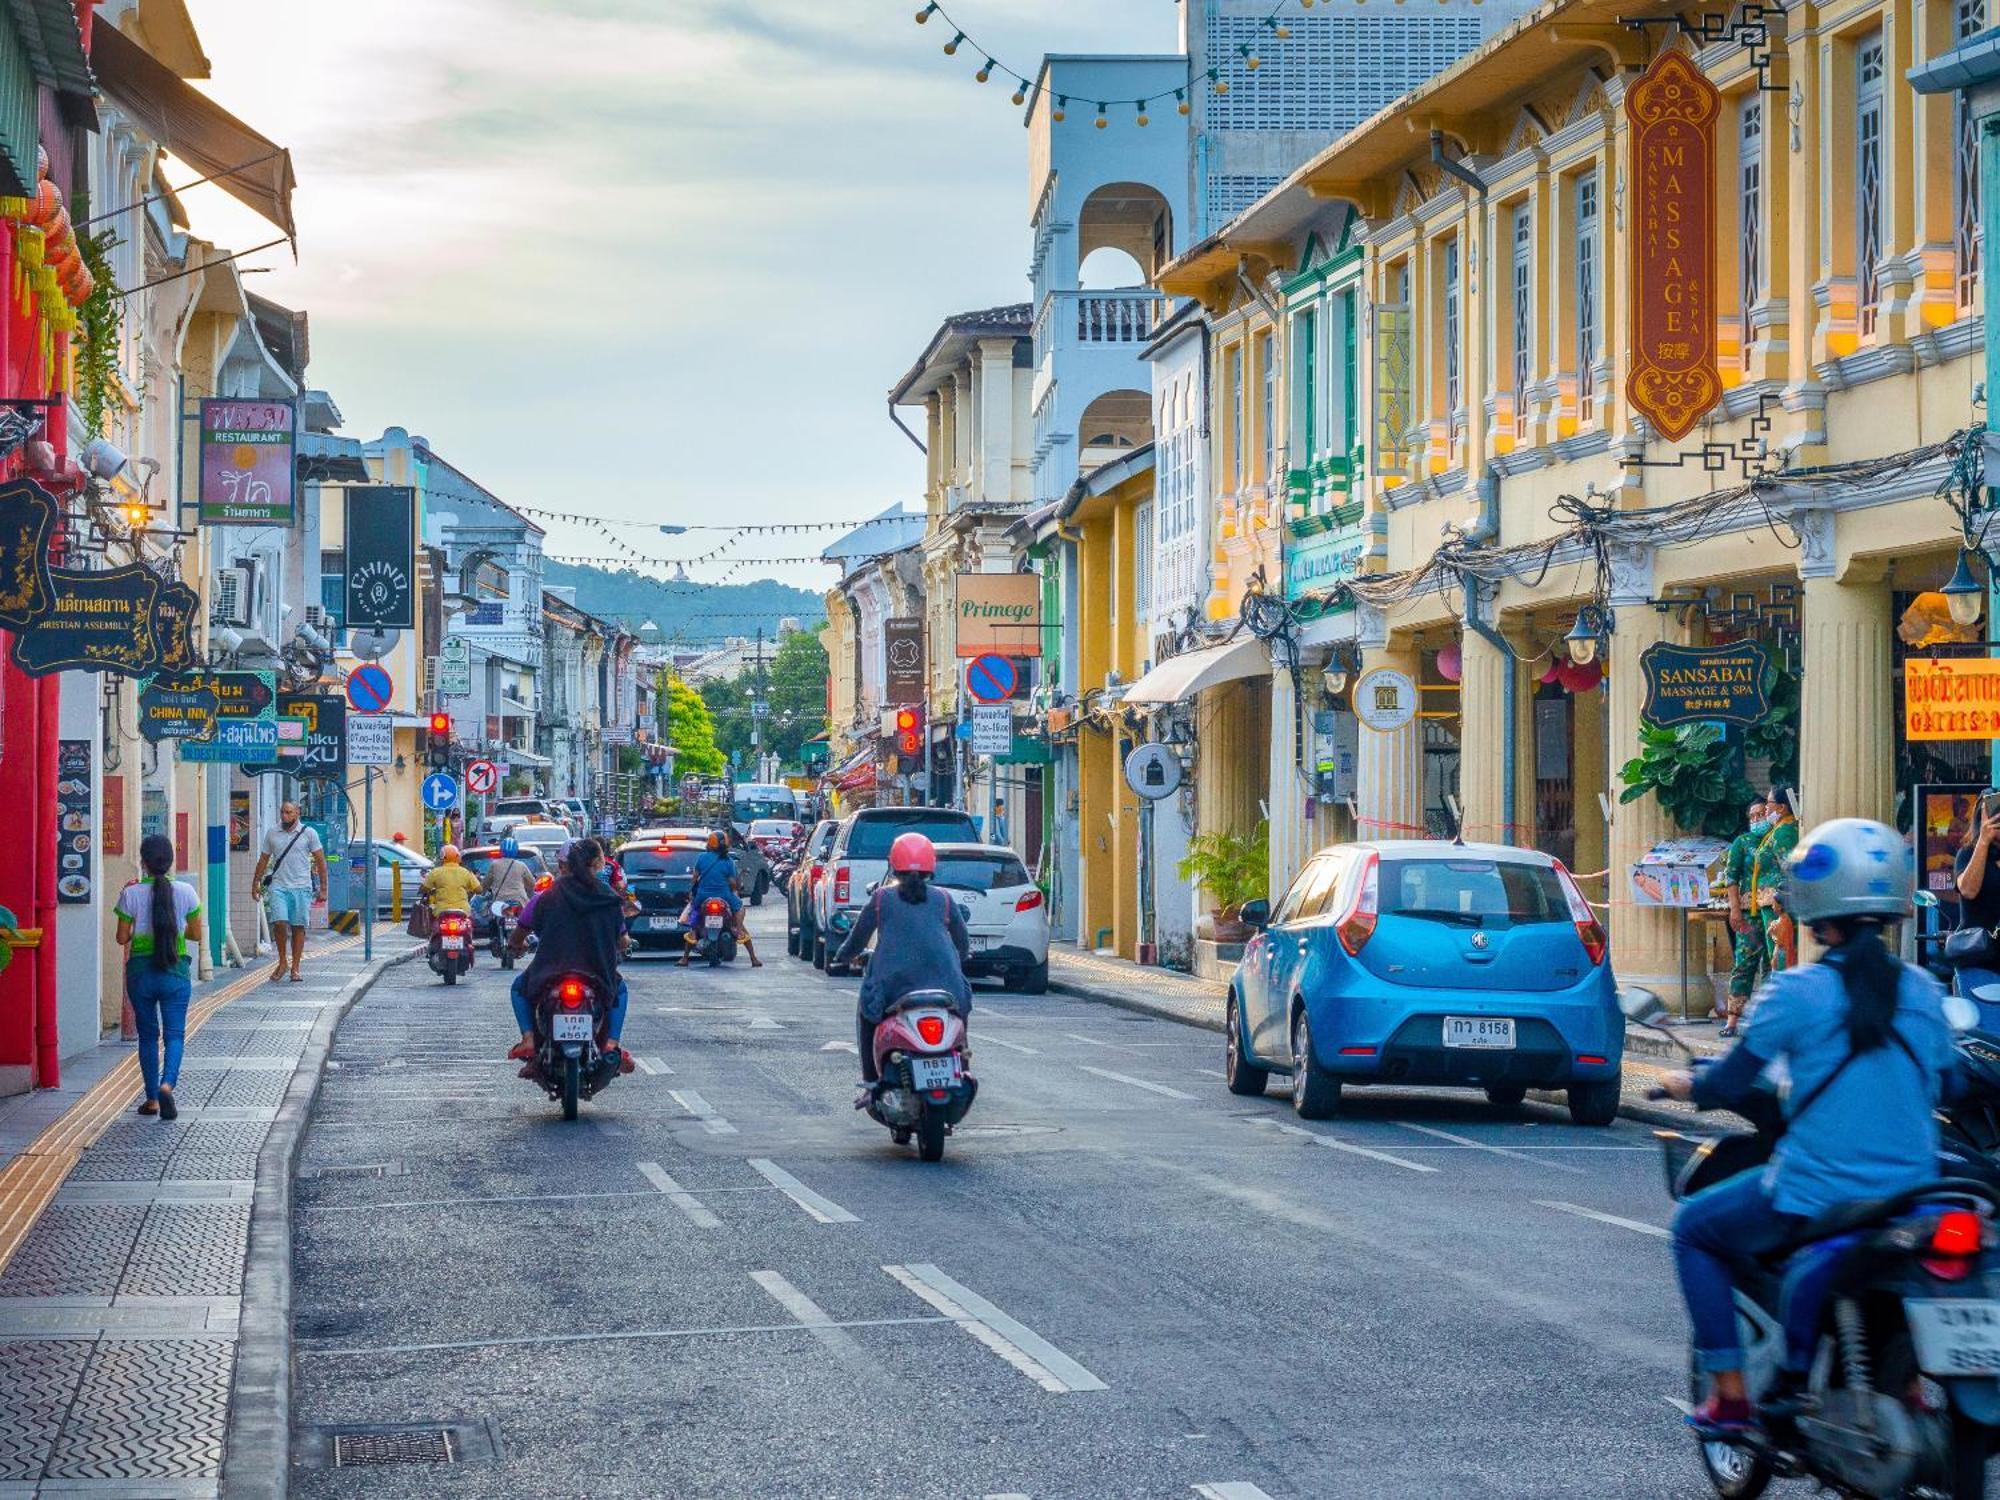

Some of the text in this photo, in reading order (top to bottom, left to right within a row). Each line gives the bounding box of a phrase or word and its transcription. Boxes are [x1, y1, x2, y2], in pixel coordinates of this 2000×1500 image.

[1648, 147, 1659, 258] SANSABAI
[1663, 146, 1684, 332] MASSAGE
[1690, 295, 1699, 334] SPA
[1658, 342, 1690, 360] 按摩
[215, 432, 282, 443] RESTAURANT
[84, 621, 130, 630] ASSEMBLY
[1660, 667, 1753, 684] SANSABAI
[1660, 685, 1754, 697] MASSAGE & SPA
[149, 707, 207, 719] CHINA INN
[223, 704, 249, 714] WILAI
[1454, 1021, 1509, 1035] กว 8158
[560, 1032, 588, 1040] 4567
